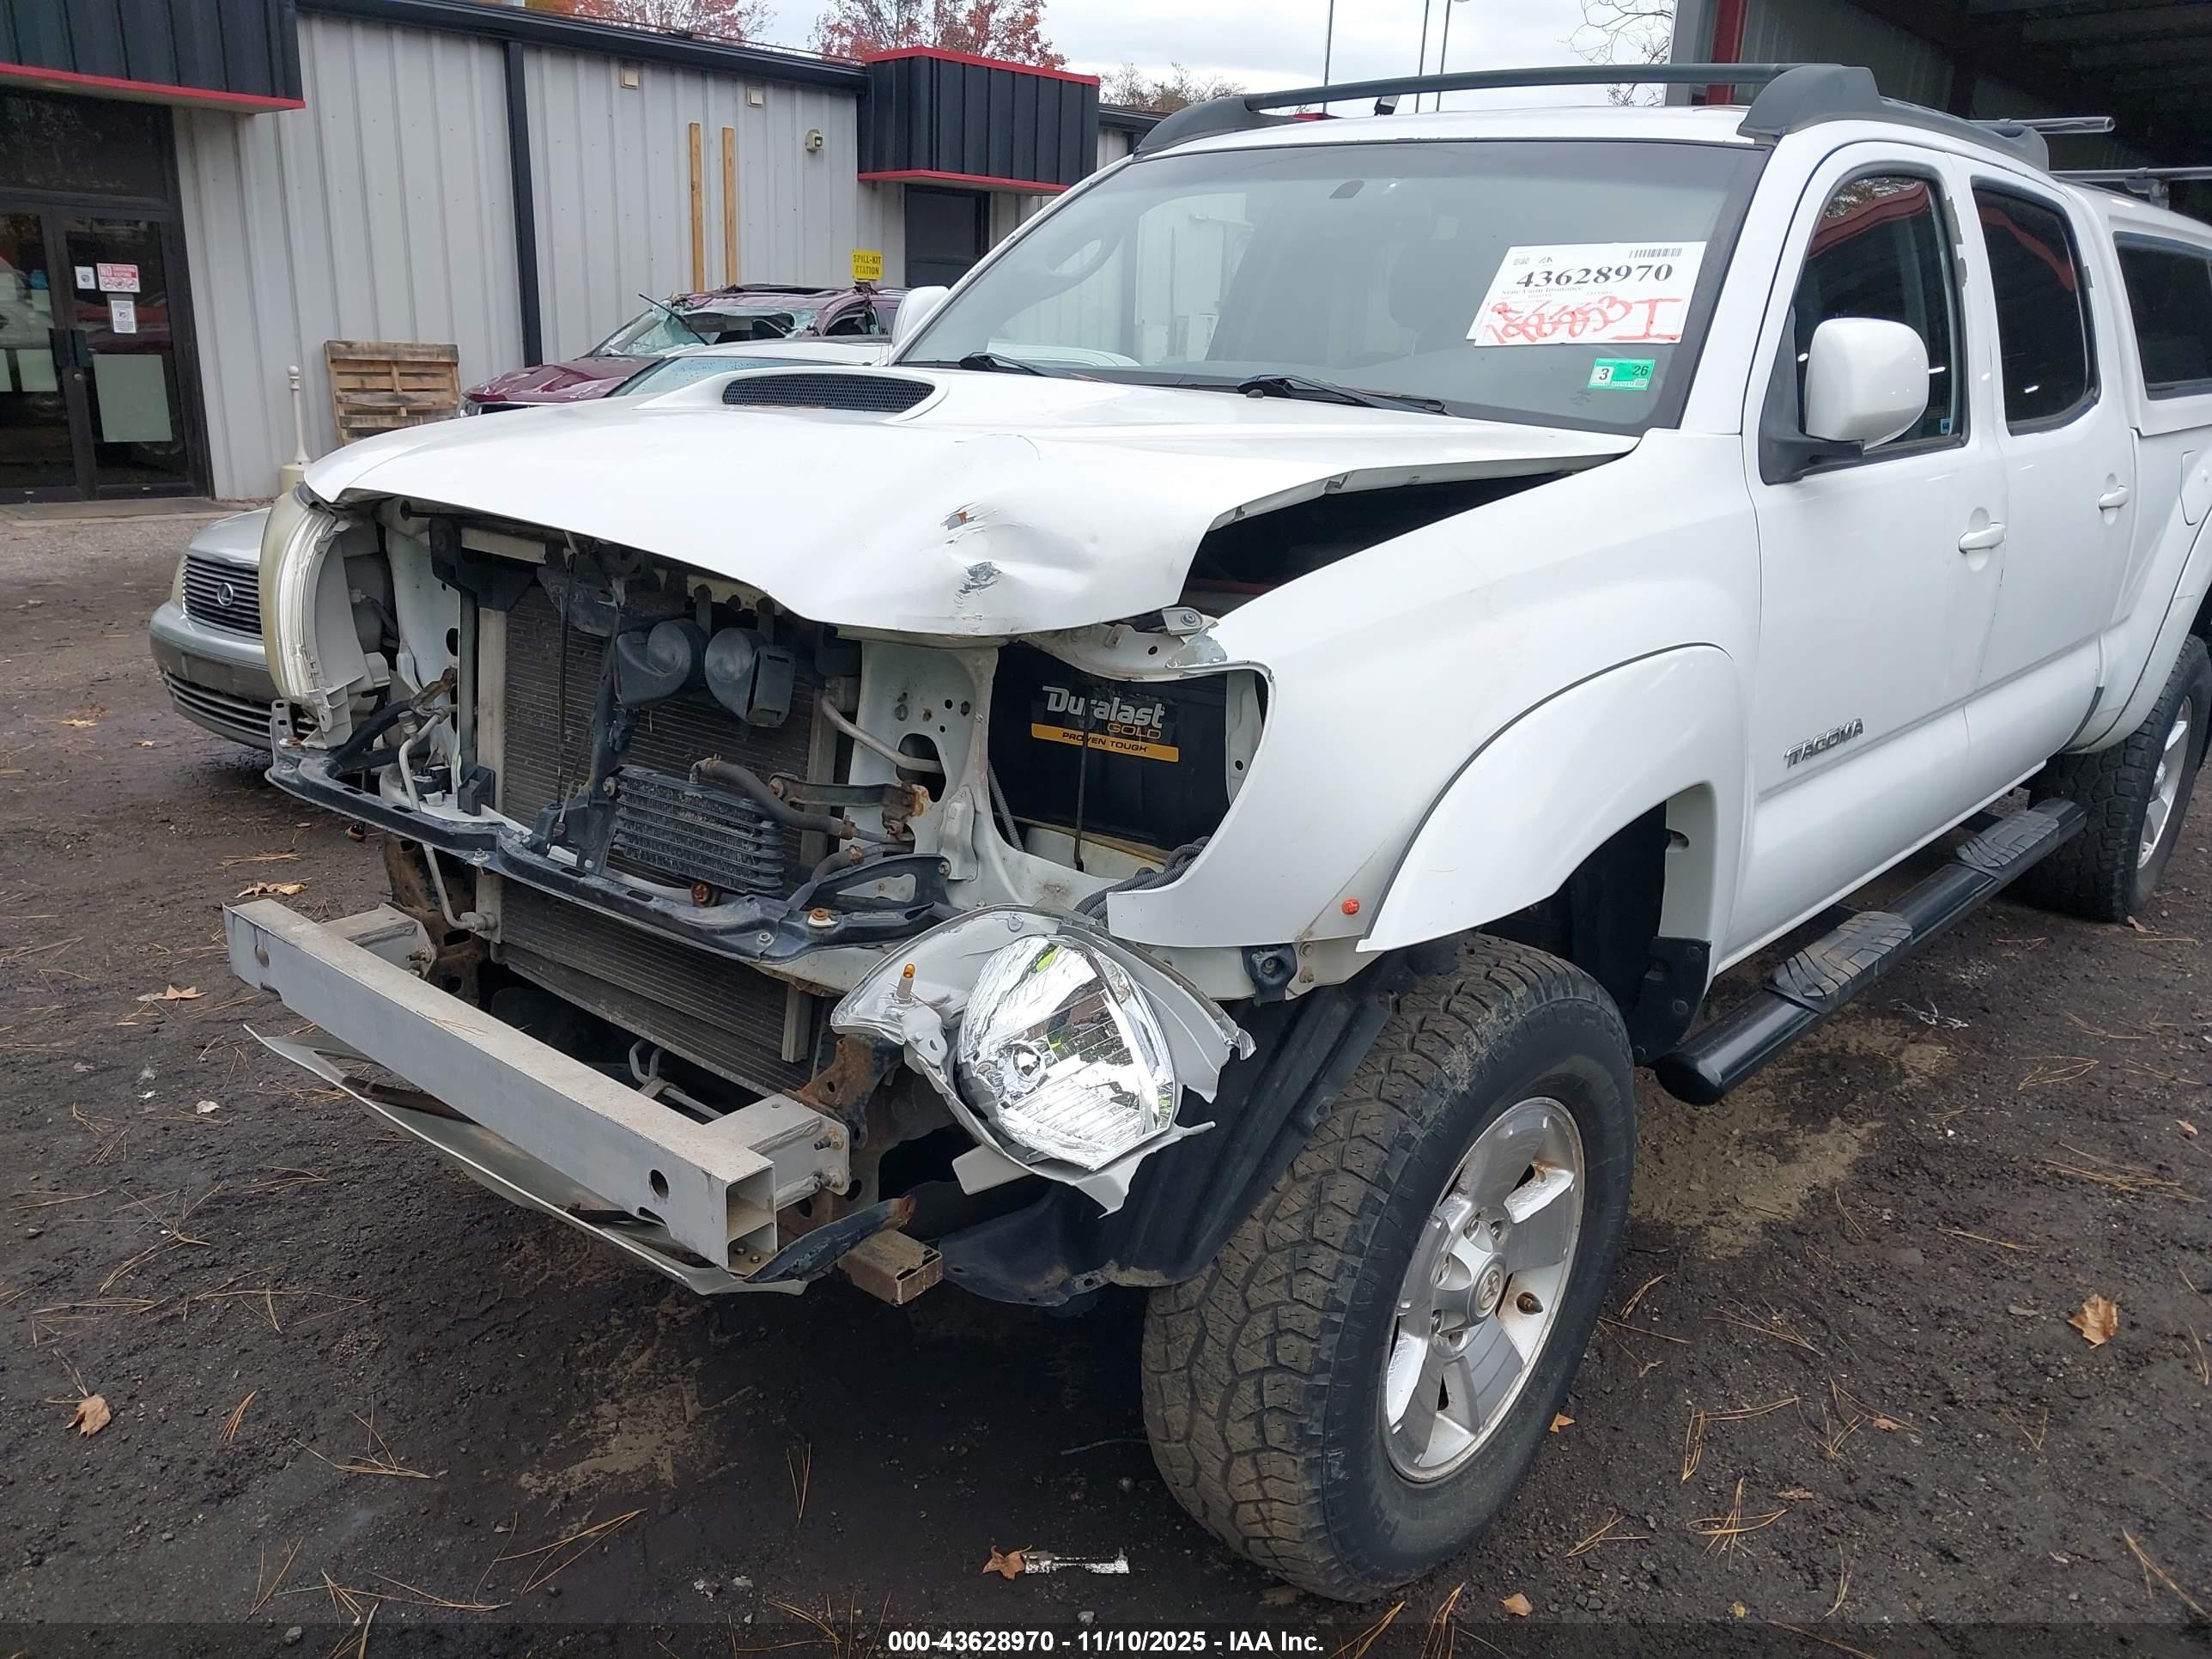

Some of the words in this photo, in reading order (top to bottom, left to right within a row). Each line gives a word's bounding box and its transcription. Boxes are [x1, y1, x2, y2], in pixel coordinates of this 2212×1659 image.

[853, 254, 881, 264] SPILL-KIT
[99, 265, 113, 277] NO
[855, 265, 879, 275] STATION
[1516, 264, 1673, 288] 43628970
[1599, 368, 1610, 380] 3
[1632, 365, 1650, 376] 26
[1107, 722, 1162, 739] GOLD
[1109, 740, 1147, 753] TOUGH
[1784, 717, 1863, 769] TACOMA
